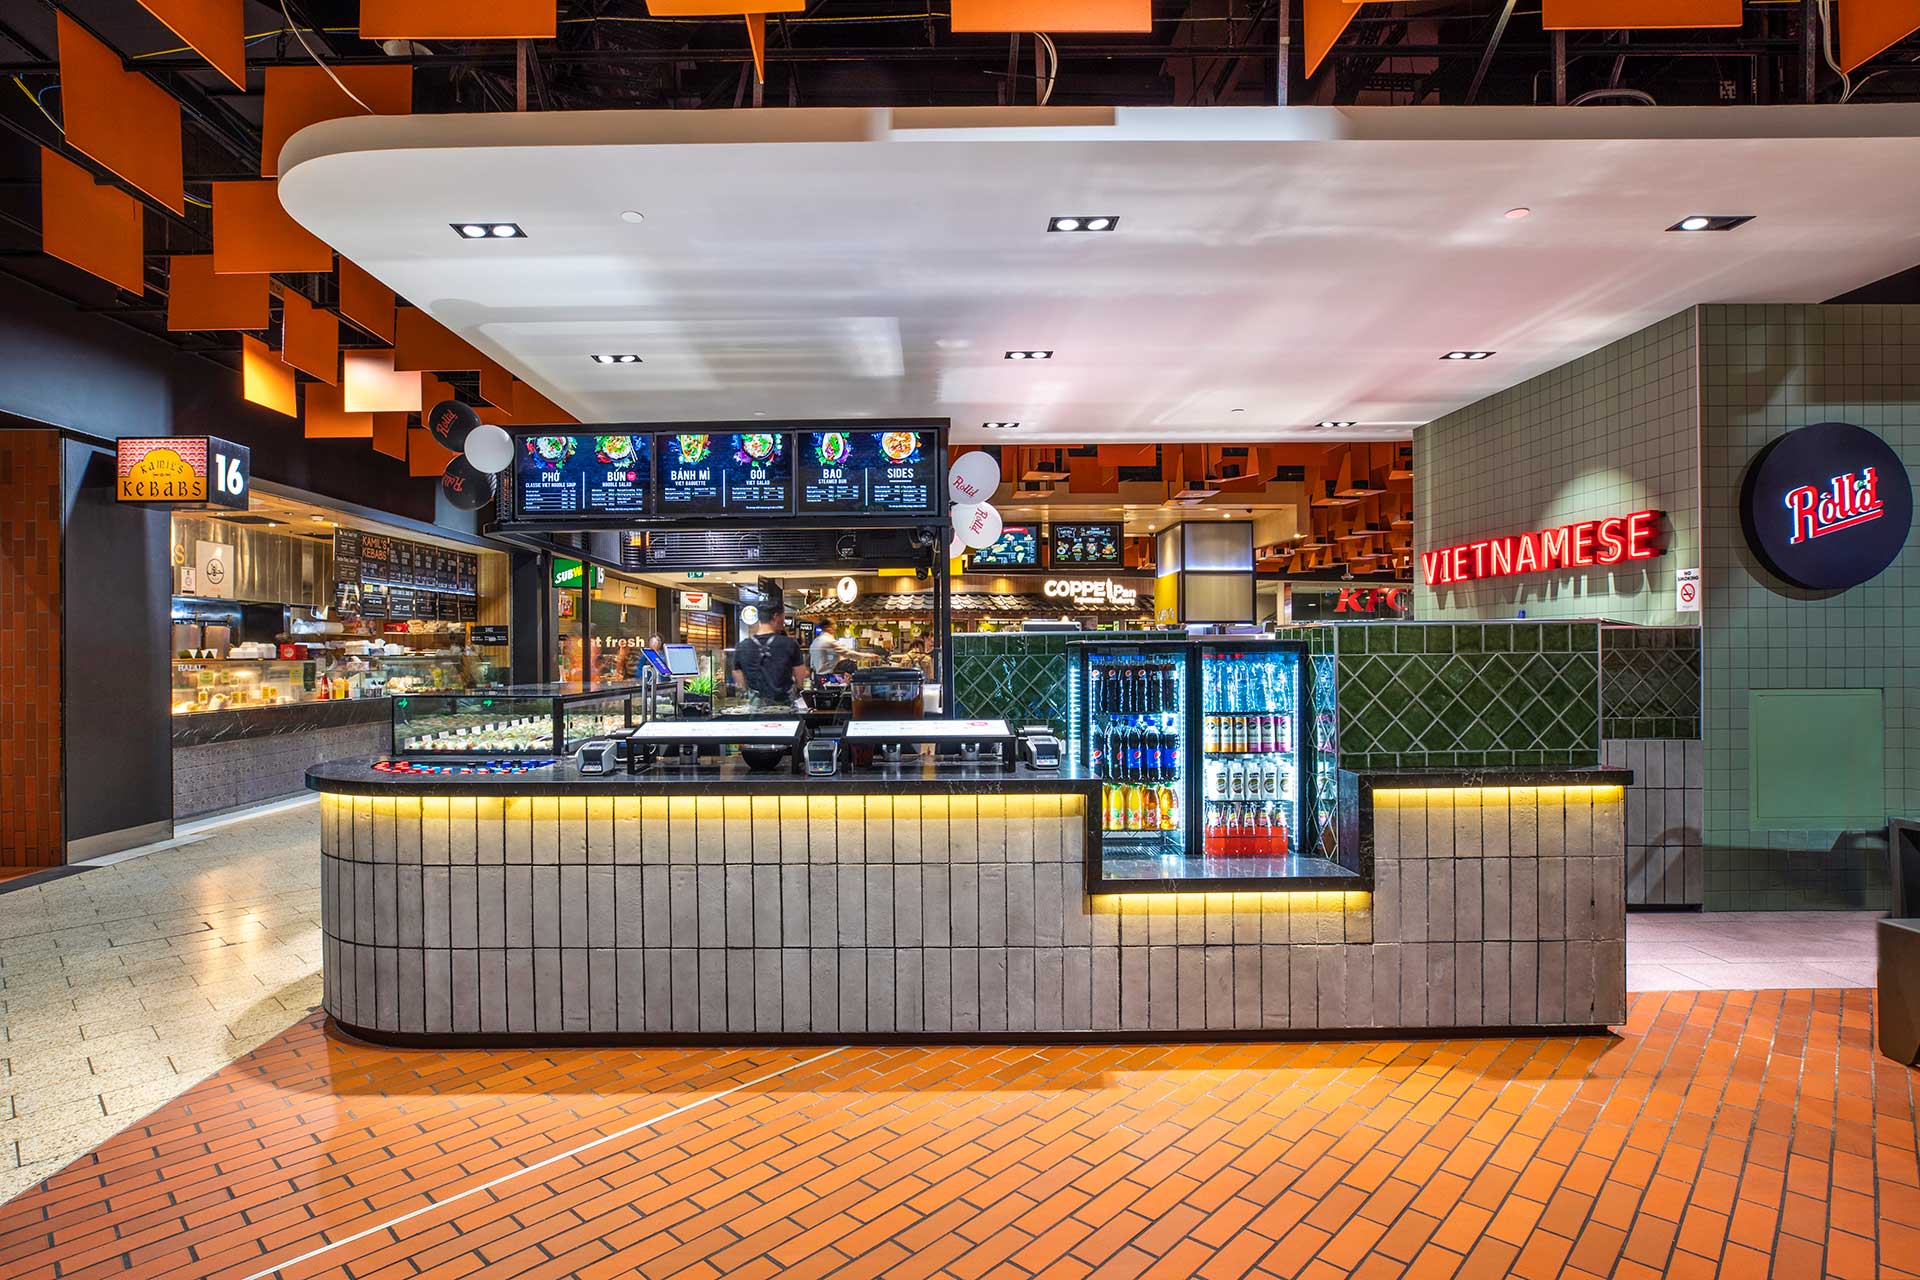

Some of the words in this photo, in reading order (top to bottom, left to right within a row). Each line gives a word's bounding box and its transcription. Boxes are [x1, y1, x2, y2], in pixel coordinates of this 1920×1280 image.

[215, 453, 244, 495] 16
[607, 468, 626, 482] BÚN
[670, 467, 696, 480] BÁNH
[822, 469, 842, 479] BAO
[887, 468, 914, 479] SIDES
[1421, 509, 1661, 585] VIETNAMESE
[1044, 580, 1106, 597] COPPE
[1333, 587, 1410, 613] KFC
[605, 636, 645, 648] fresh
